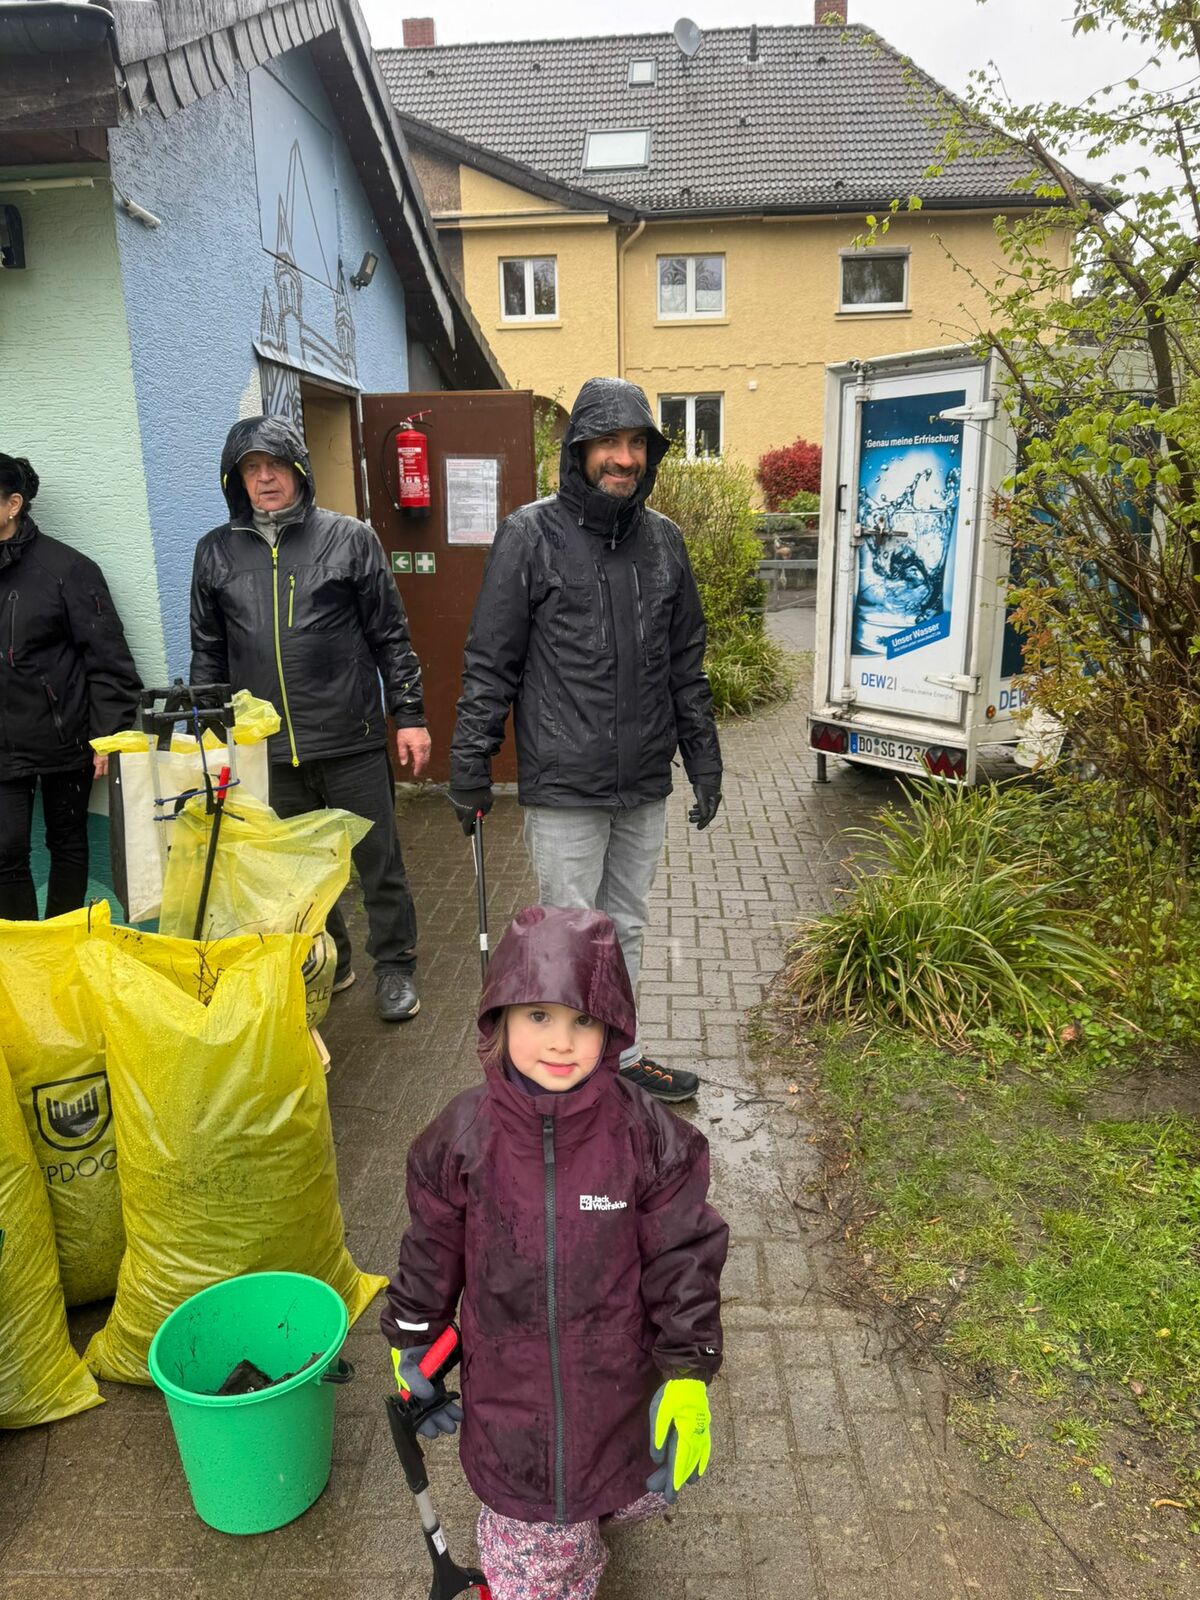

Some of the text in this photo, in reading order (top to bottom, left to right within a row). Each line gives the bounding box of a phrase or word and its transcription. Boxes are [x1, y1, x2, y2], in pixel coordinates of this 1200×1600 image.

[890, 437, 913, 447] meine
[913, 433, 960, 446] Erfrischung
[891, 633, 913, 648] Unser
[912, 622, 940, 639] Wasser
[860, 672, 897, 691] DEW21
[880, 741, 895, 758] SG
[592, 1194, 610, 1204] Jack
[592, 1200, 628, 1211] Wolfskin
